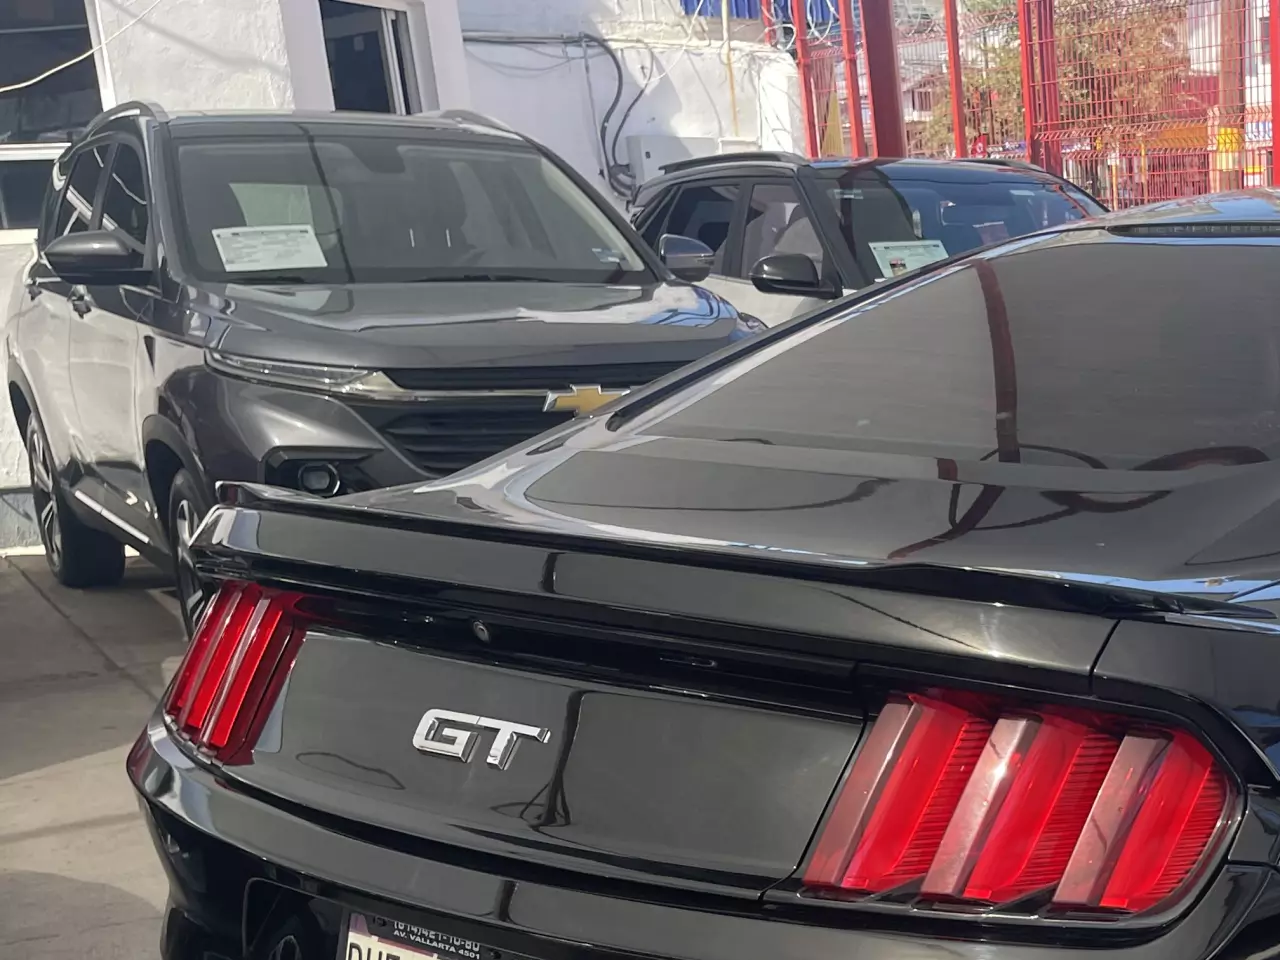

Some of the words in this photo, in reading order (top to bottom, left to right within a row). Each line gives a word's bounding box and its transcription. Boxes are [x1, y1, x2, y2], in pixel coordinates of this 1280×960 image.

[412, 708, 551, 770] GT
[393, 930, 408, 939] AV.
[409, 934, 456, 953] VALLARTA
[458, 949, 480, 960] 4501
